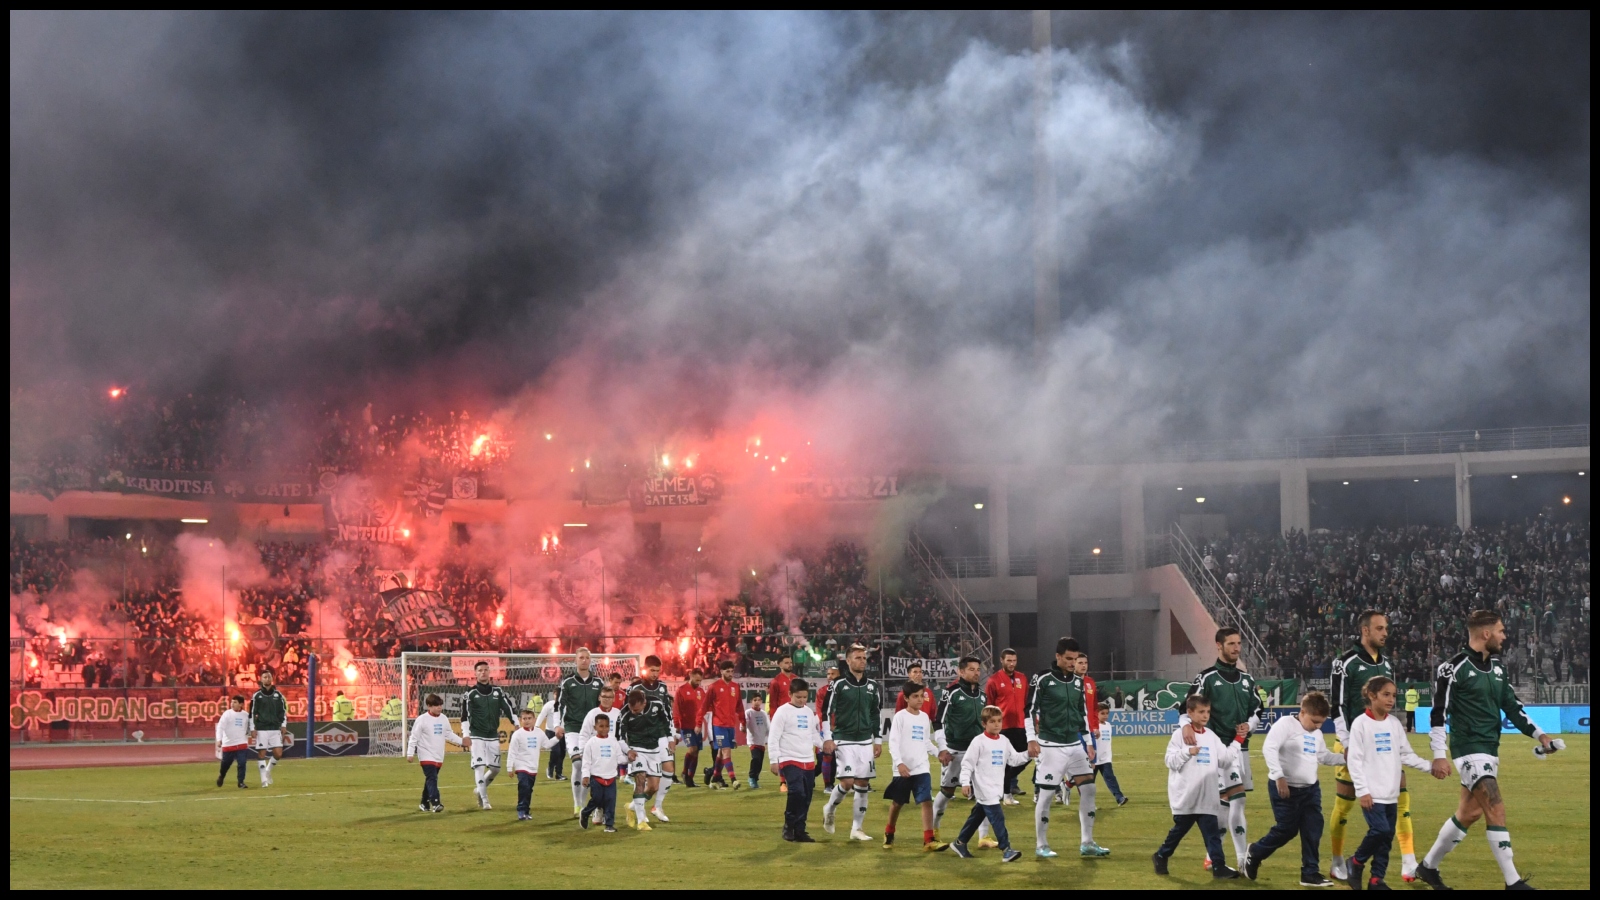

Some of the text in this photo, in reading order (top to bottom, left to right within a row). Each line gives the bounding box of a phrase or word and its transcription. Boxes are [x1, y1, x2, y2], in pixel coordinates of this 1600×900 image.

[126, 476, 216, 495] KARDITSA
[254, 483, 302, 497] GATE
[644, 476, 696, 493] NEMEA
[425, 608, 456, 628] 13
[49, 697, 147, 722] JORDAN
[1111, 711, 1166, 723] ΑΣΤΙΚΕΣ
